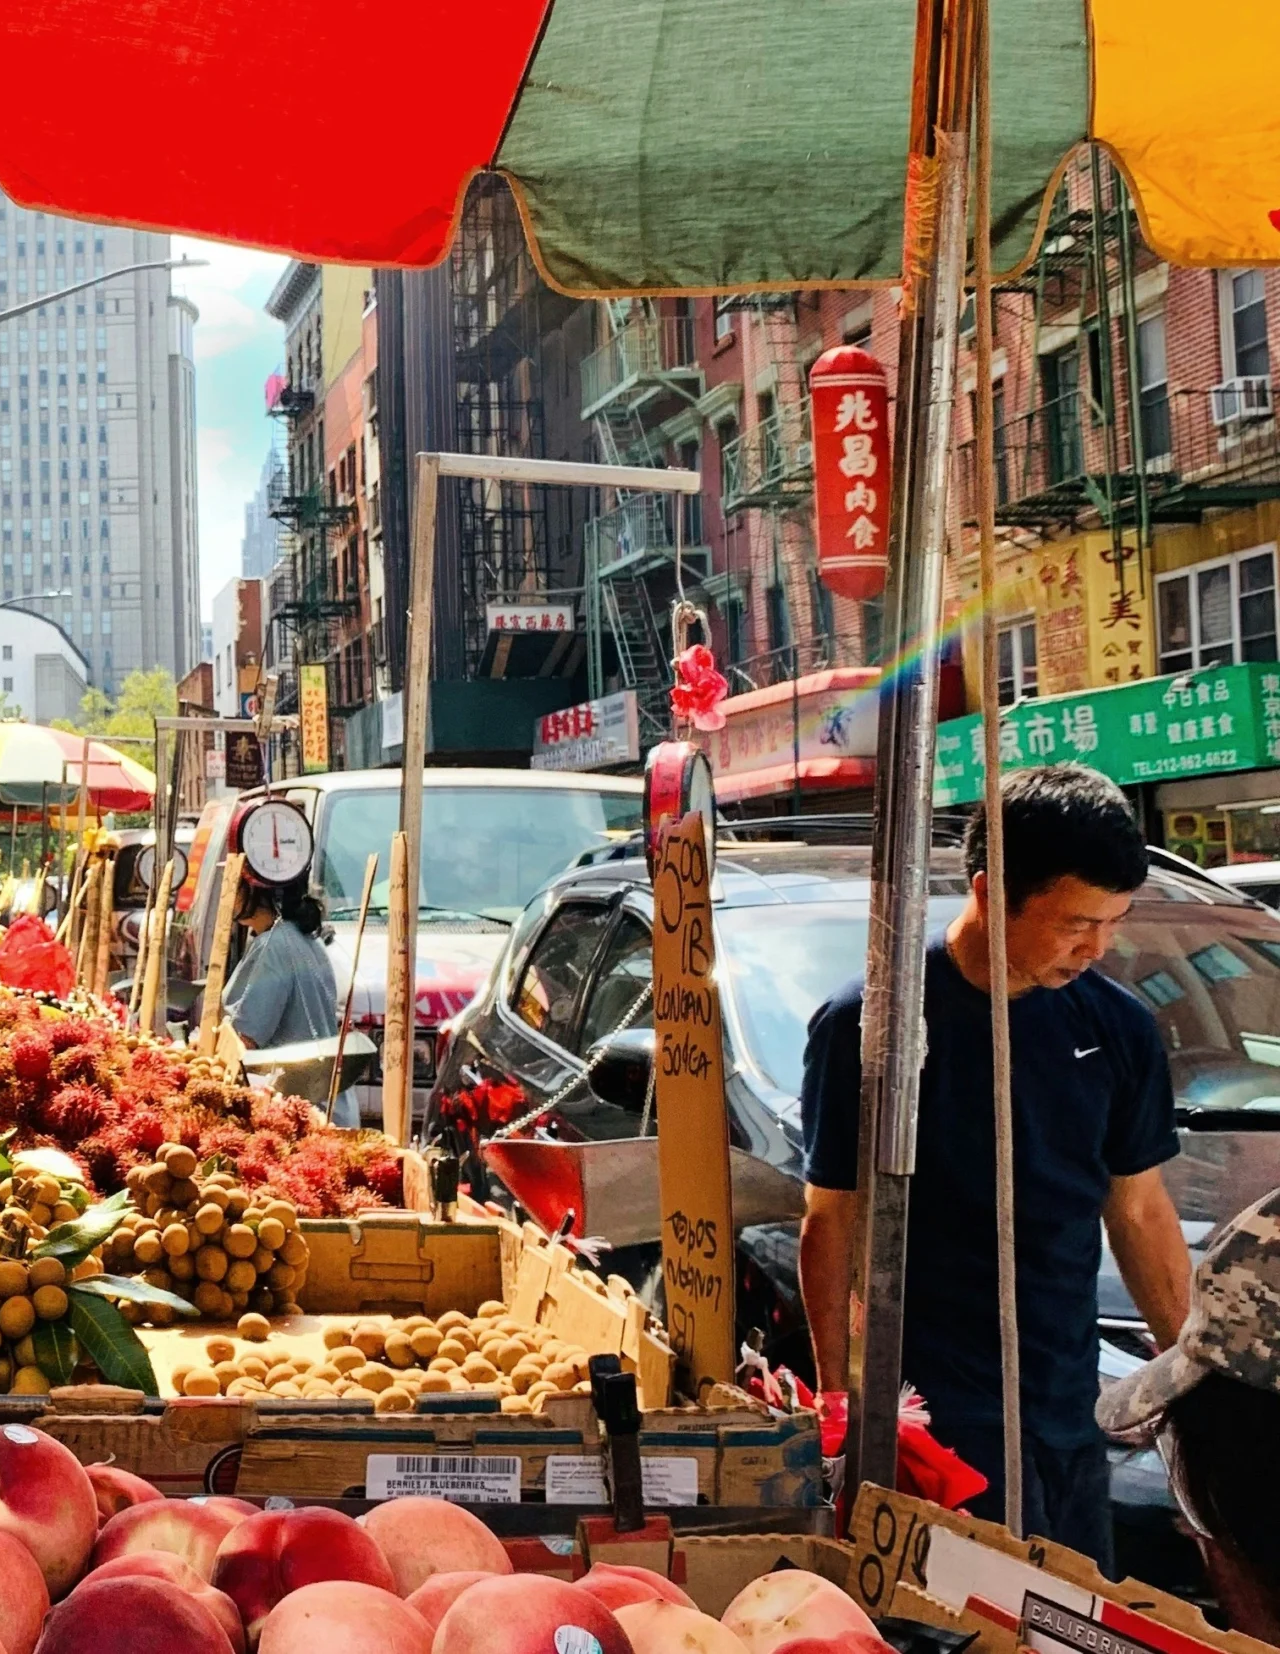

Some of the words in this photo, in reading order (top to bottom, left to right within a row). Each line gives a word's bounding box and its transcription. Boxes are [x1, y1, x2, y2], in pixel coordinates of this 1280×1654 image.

[833, 390, 880, 550] 兆昌肉食
[1099, 546, 1141, 630] 中美
[386, 1480, 421, 1489] BERRIES
[429, 1480, 486, 1490] BLUEBERRIES
[1029, 1603, 1149, 1654] CALIFORNI
